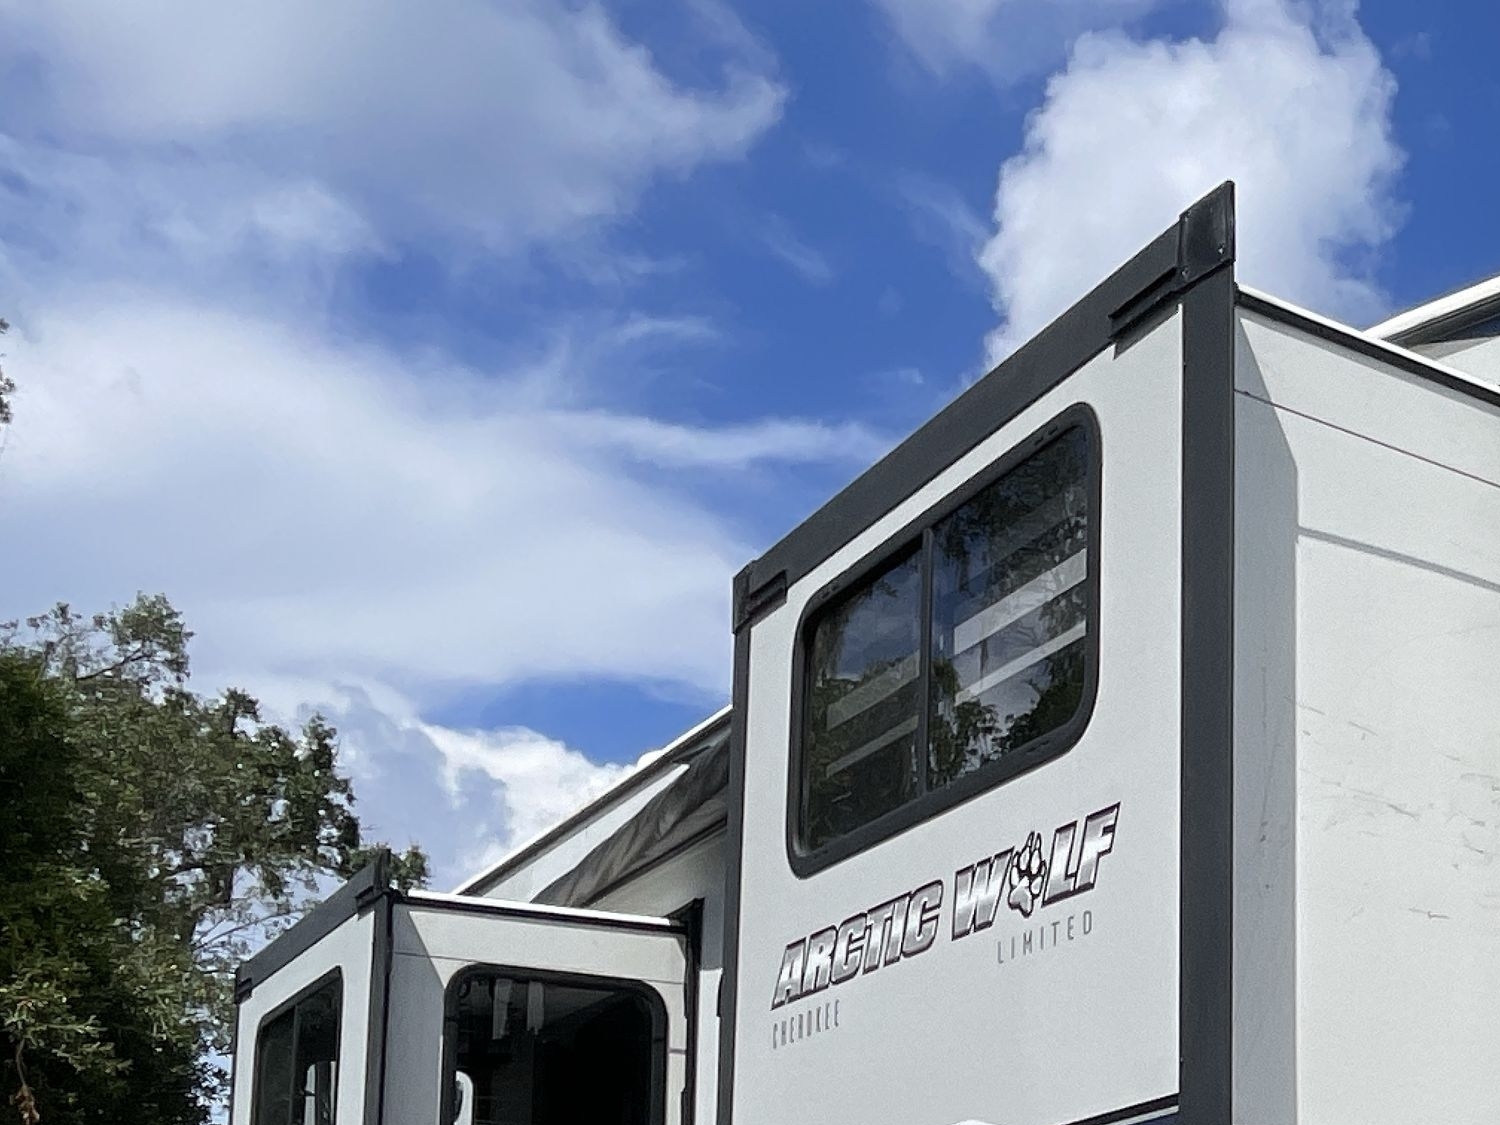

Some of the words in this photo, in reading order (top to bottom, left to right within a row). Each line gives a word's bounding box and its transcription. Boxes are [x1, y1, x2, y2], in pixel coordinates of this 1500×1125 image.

[770, 879, 943, 1010] ARCTIC
[997, 909, 1093, 964] LIMITED
[772, 999, 840, 1049] CHEROKEE
